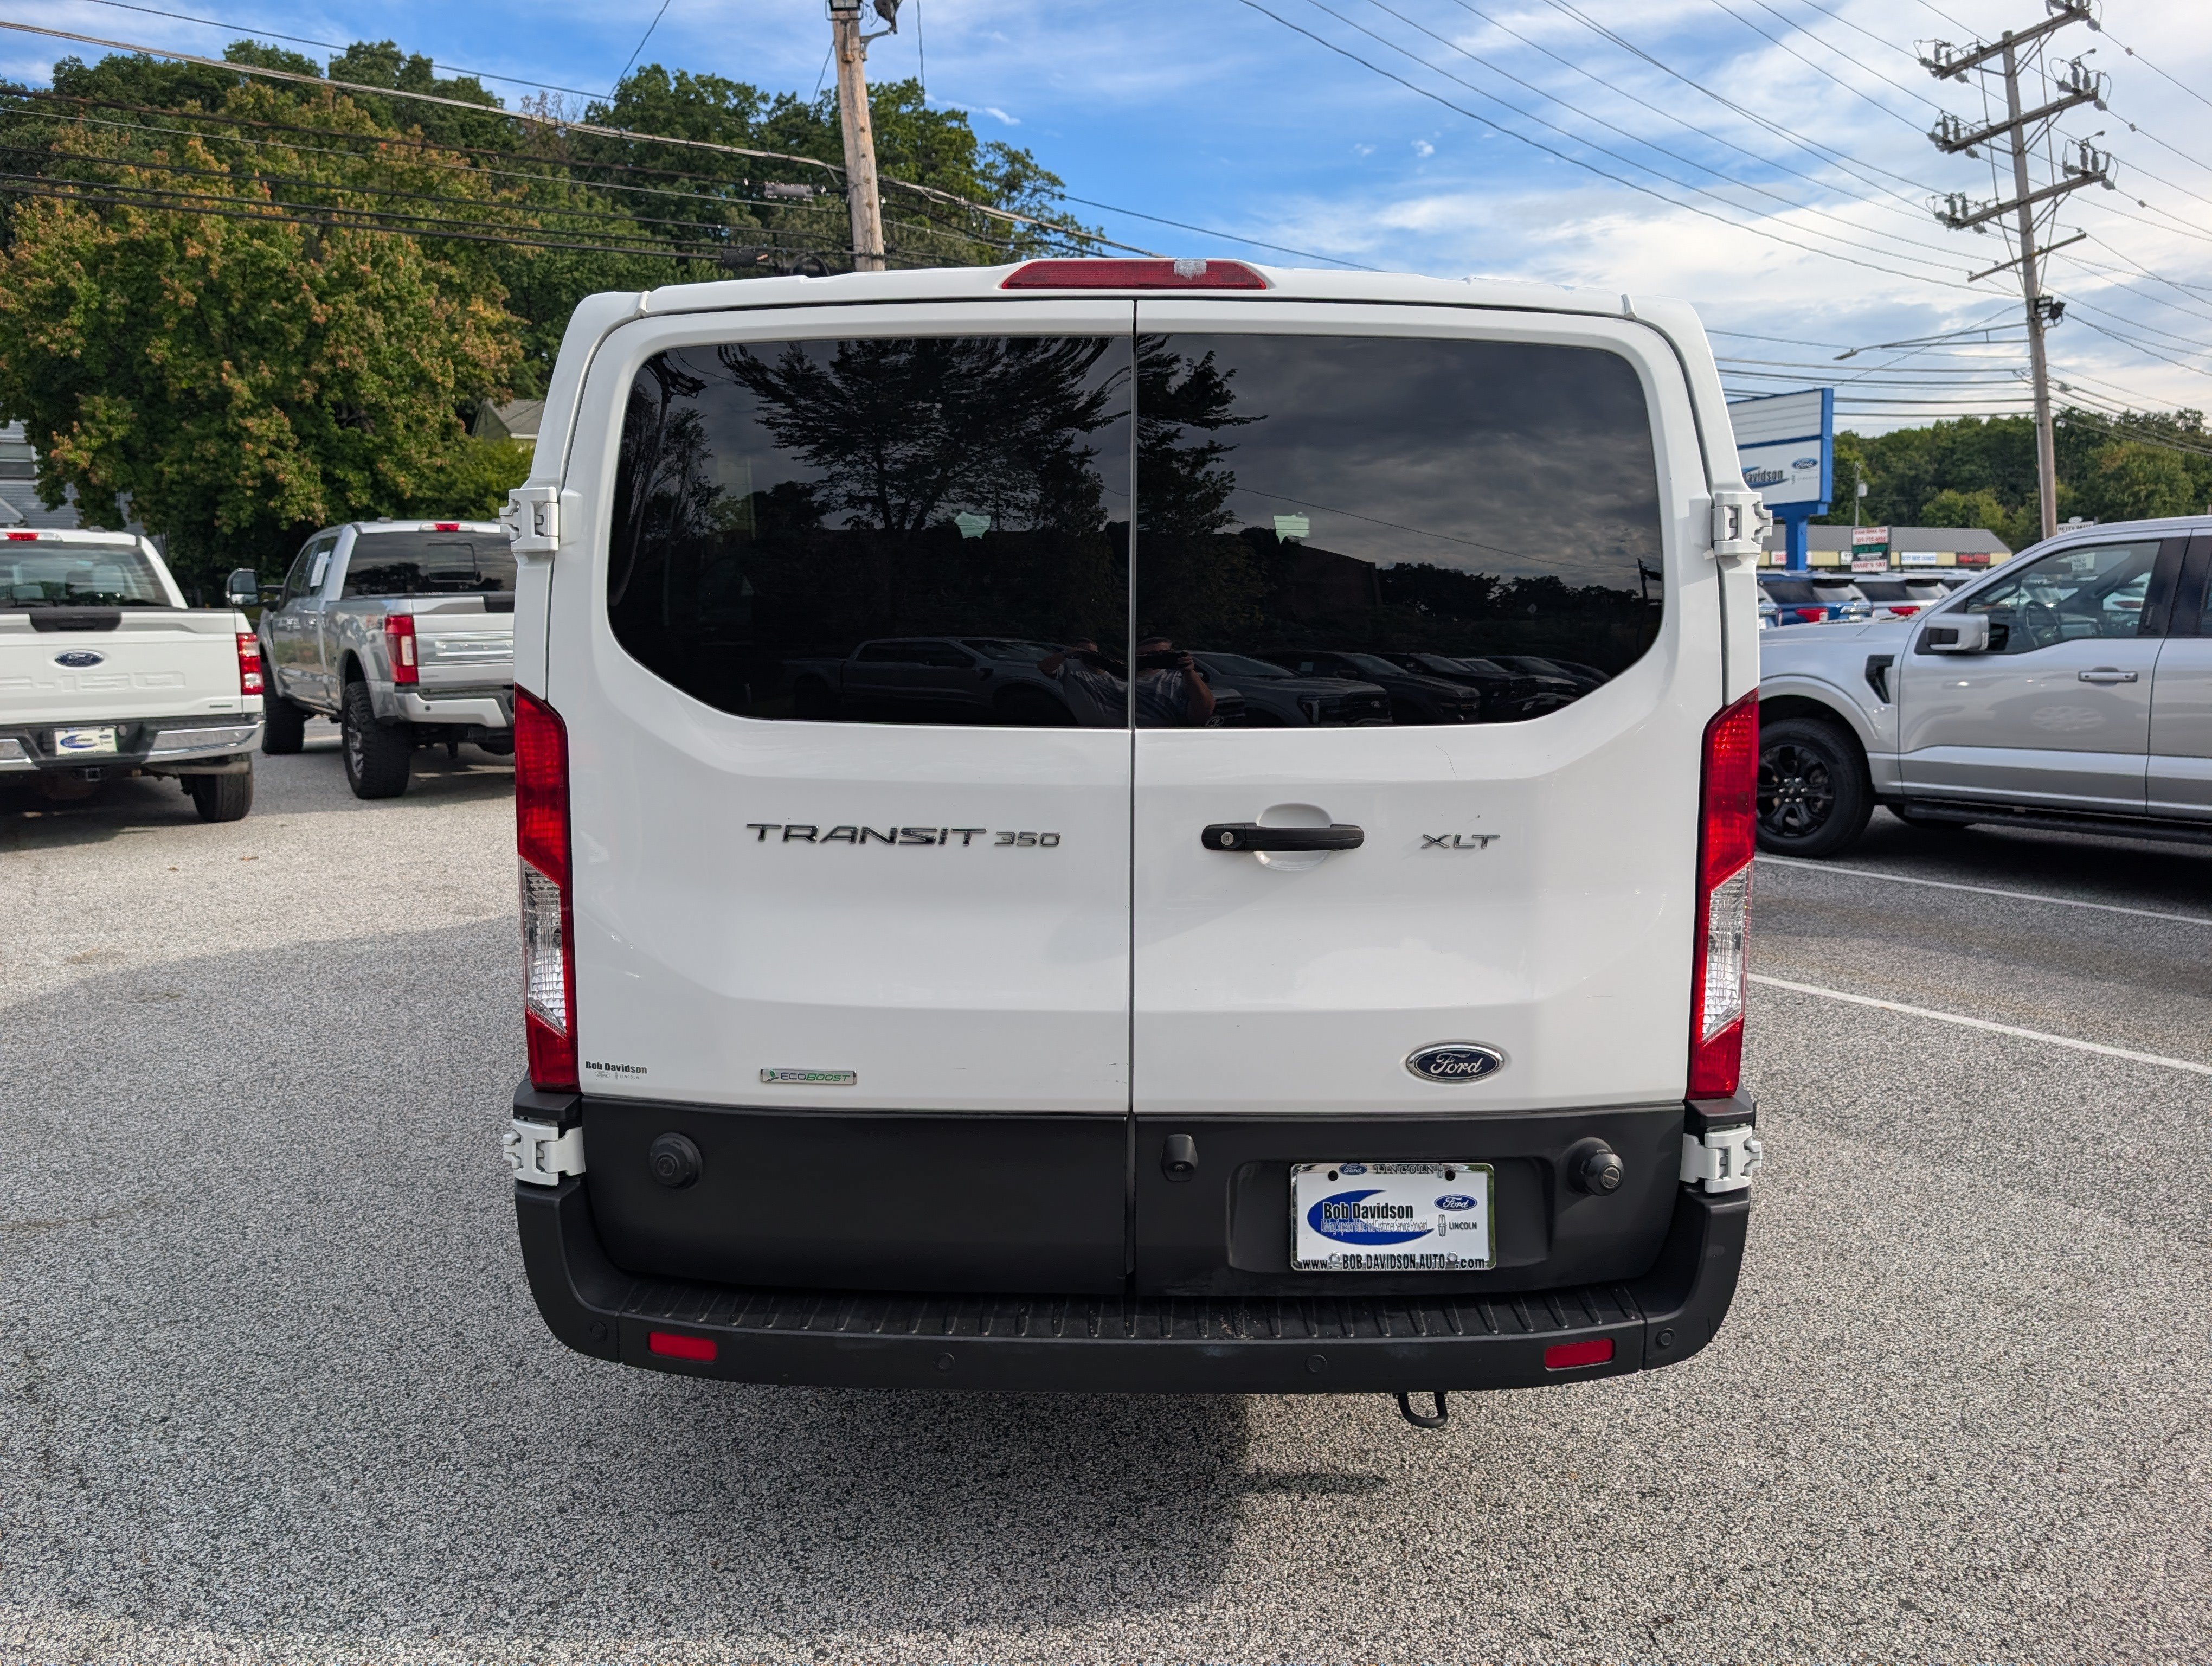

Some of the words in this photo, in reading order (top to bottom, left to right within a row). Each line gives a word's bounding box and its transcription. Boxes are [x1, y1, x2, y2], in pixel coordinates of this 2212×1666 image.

[67, 652, 93, 665] Ford
[746, 823, 987, 847] TRANSIT
[994, 831, 1062, 847] 350
[1420, 833, 1501, 849] XLT
[585, 1061, 603, 1071] Bob
[604, 1062, 647, 1074] Davidson
[1430, 1053, 1483, 1074] Ford
[780, 1072, 851, 1082] ECOBOOST
[1343, 1164, 1362, 1174] Ford
[1375, 1164, 1435, 1175] LINCOLN
[1441, 1197, 1470, 1209] Ford
[1323, 1202, 1349, 1219] Bob
[1352, 1202, 1413, 1219] Davidson
[1374, 1219, 1395, 1232] Customer
[1395, 1219, 1410, 1232] Service
[1410, 1218, 1428, 1232] Forward
[1448, 1222, 1477, 1230] LINCOLN
[1342, 1254, 1362, 1270] BOB
[1366, 1253, 1416, 1270] DAVIDSON
[1419, 1253, 1445, 1269] AUTO
